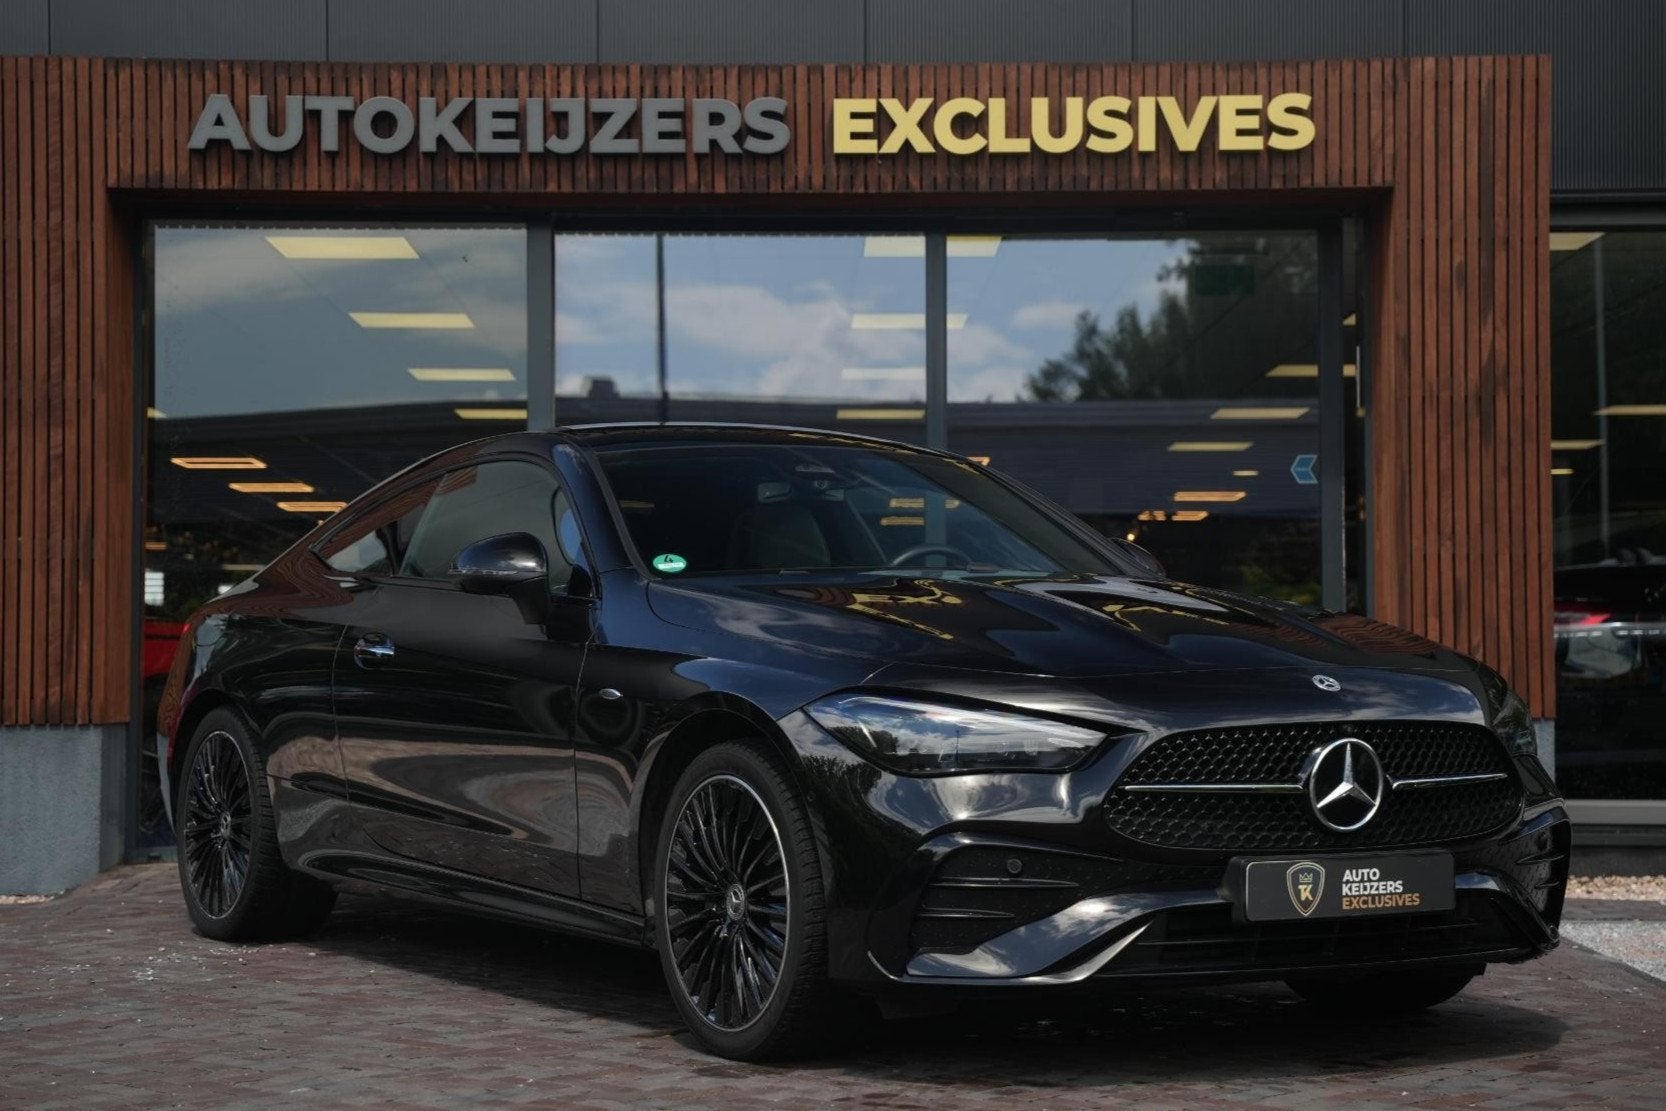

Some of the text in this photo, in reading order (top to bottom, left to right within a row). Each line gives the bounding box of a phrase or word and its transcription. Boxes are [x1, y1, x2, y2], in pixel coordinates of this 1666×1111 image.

[188, 92, 1317, 156] AUTOKEIJZERS EXCLUSIVES
[1342, 868, 1380, 882] AUTO
[1342, 881, 1403, 896] KEIJZERS
[1342, 893, 1420, 910] EXCLUSIVES
